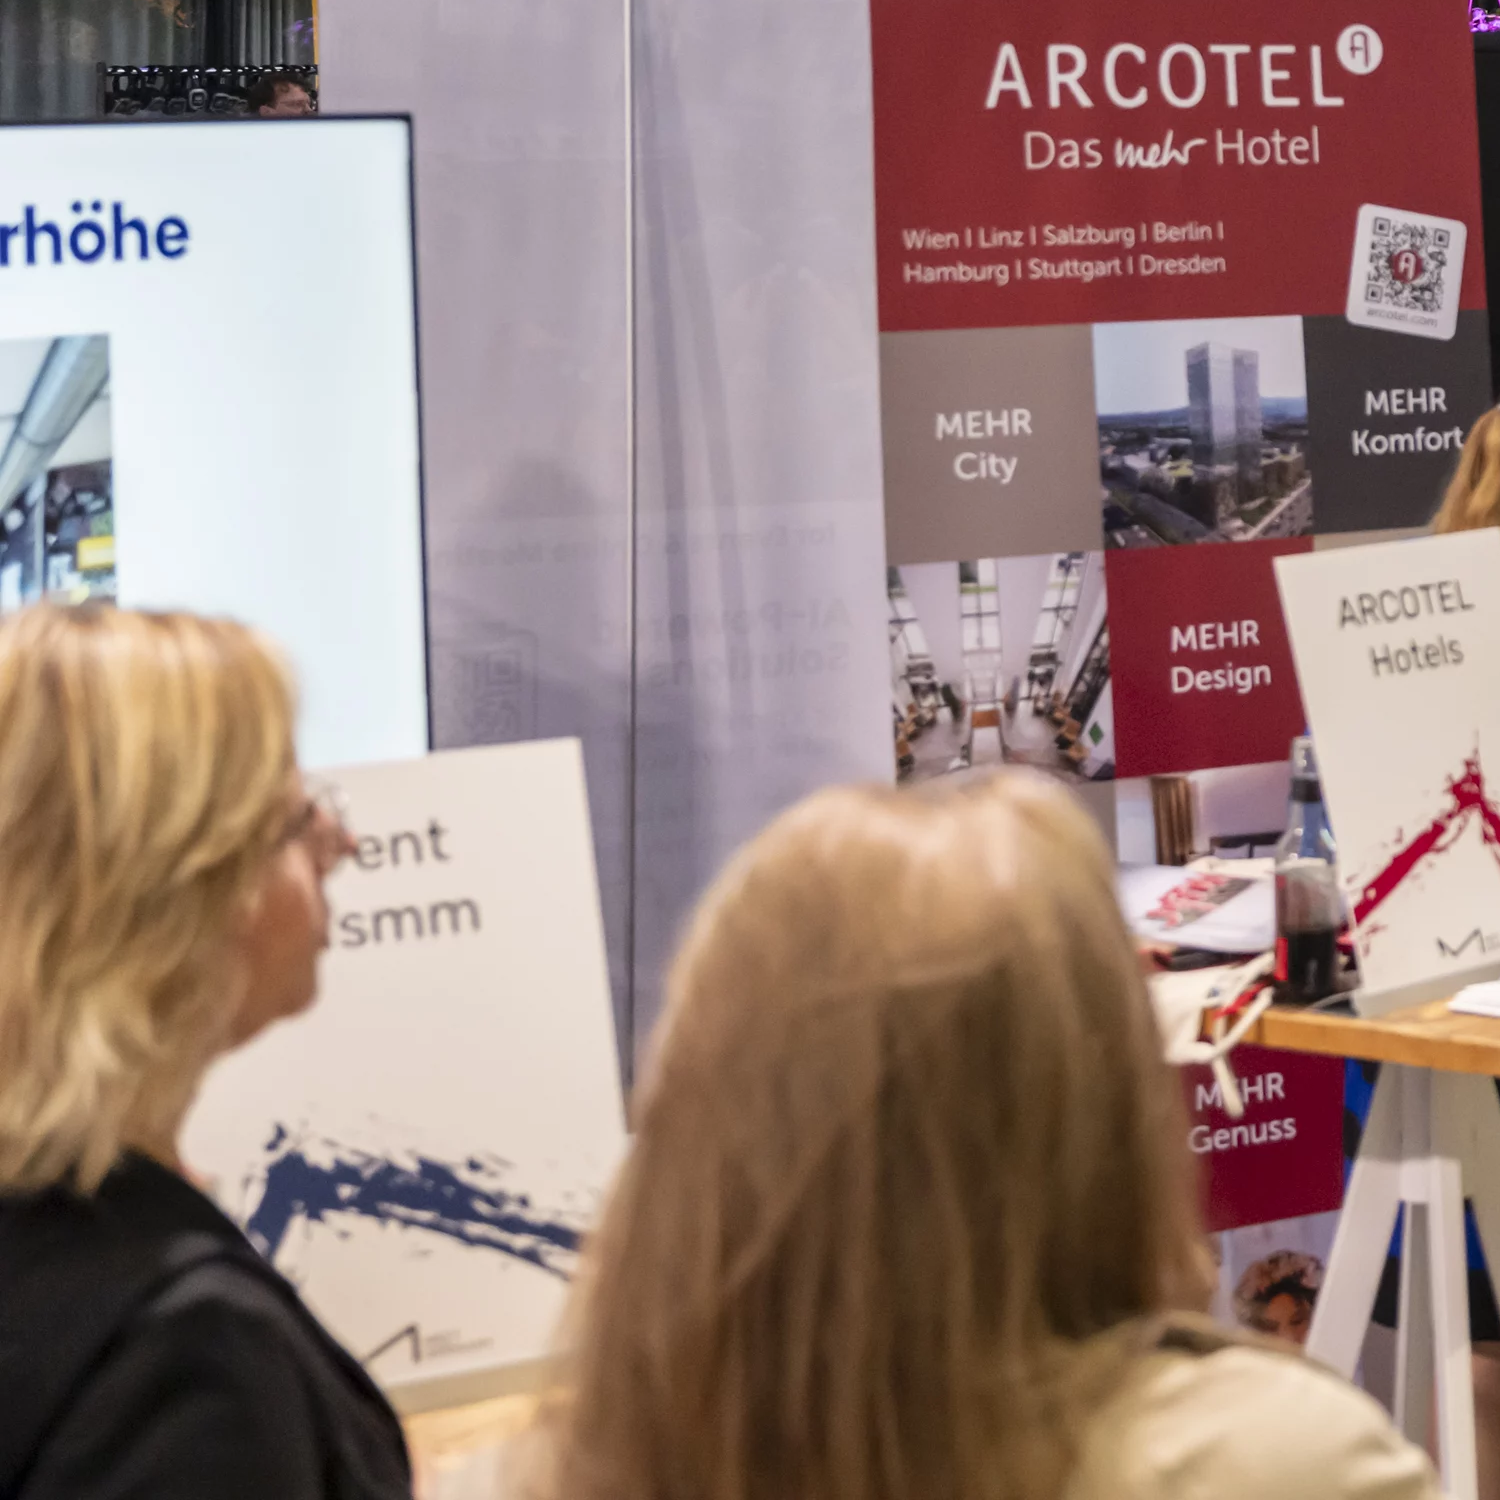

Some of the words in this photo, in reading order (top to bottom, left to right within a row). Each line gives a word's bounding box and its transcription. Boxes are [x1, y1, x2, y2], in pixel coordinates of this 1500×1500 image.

[985, 42, 1345, 110] ARCOTEL
[1024, 130, 1103, 171] Das
[1114, 128, 1209, 170] mehr
[1216, 125, 1321, 166] Hotel
[902, 228, 960, 251] Wien
[979, 226, 1024, 249] Linz
[1042, 223, 1136, 252] Salzburg
[1153, 221, 1213, 244] Berlin
[902, 259, 1010, 289] Hamburg
[1028, 256, 1124, 283] Stuttgart
[1139, 252, 1227, 277] Dresden
[1364, 386, 1447, 417] MEHR
[934, 407, 1033, 441] MEHR
[1351, 424, 1464, 457] Komfort
[952, 450, 1018, 486] City
[1339, 579, 1474, 630] ARCOTEL
[1170, 618, 1260, 654] MEHR
[1369, 634, 1465, 678] Hotels
[1170, 661, 1272, 697] Design
[1194, 1071, 1286, 1111] MHR
[1186, 1117, 1298, 1154] Genuss
